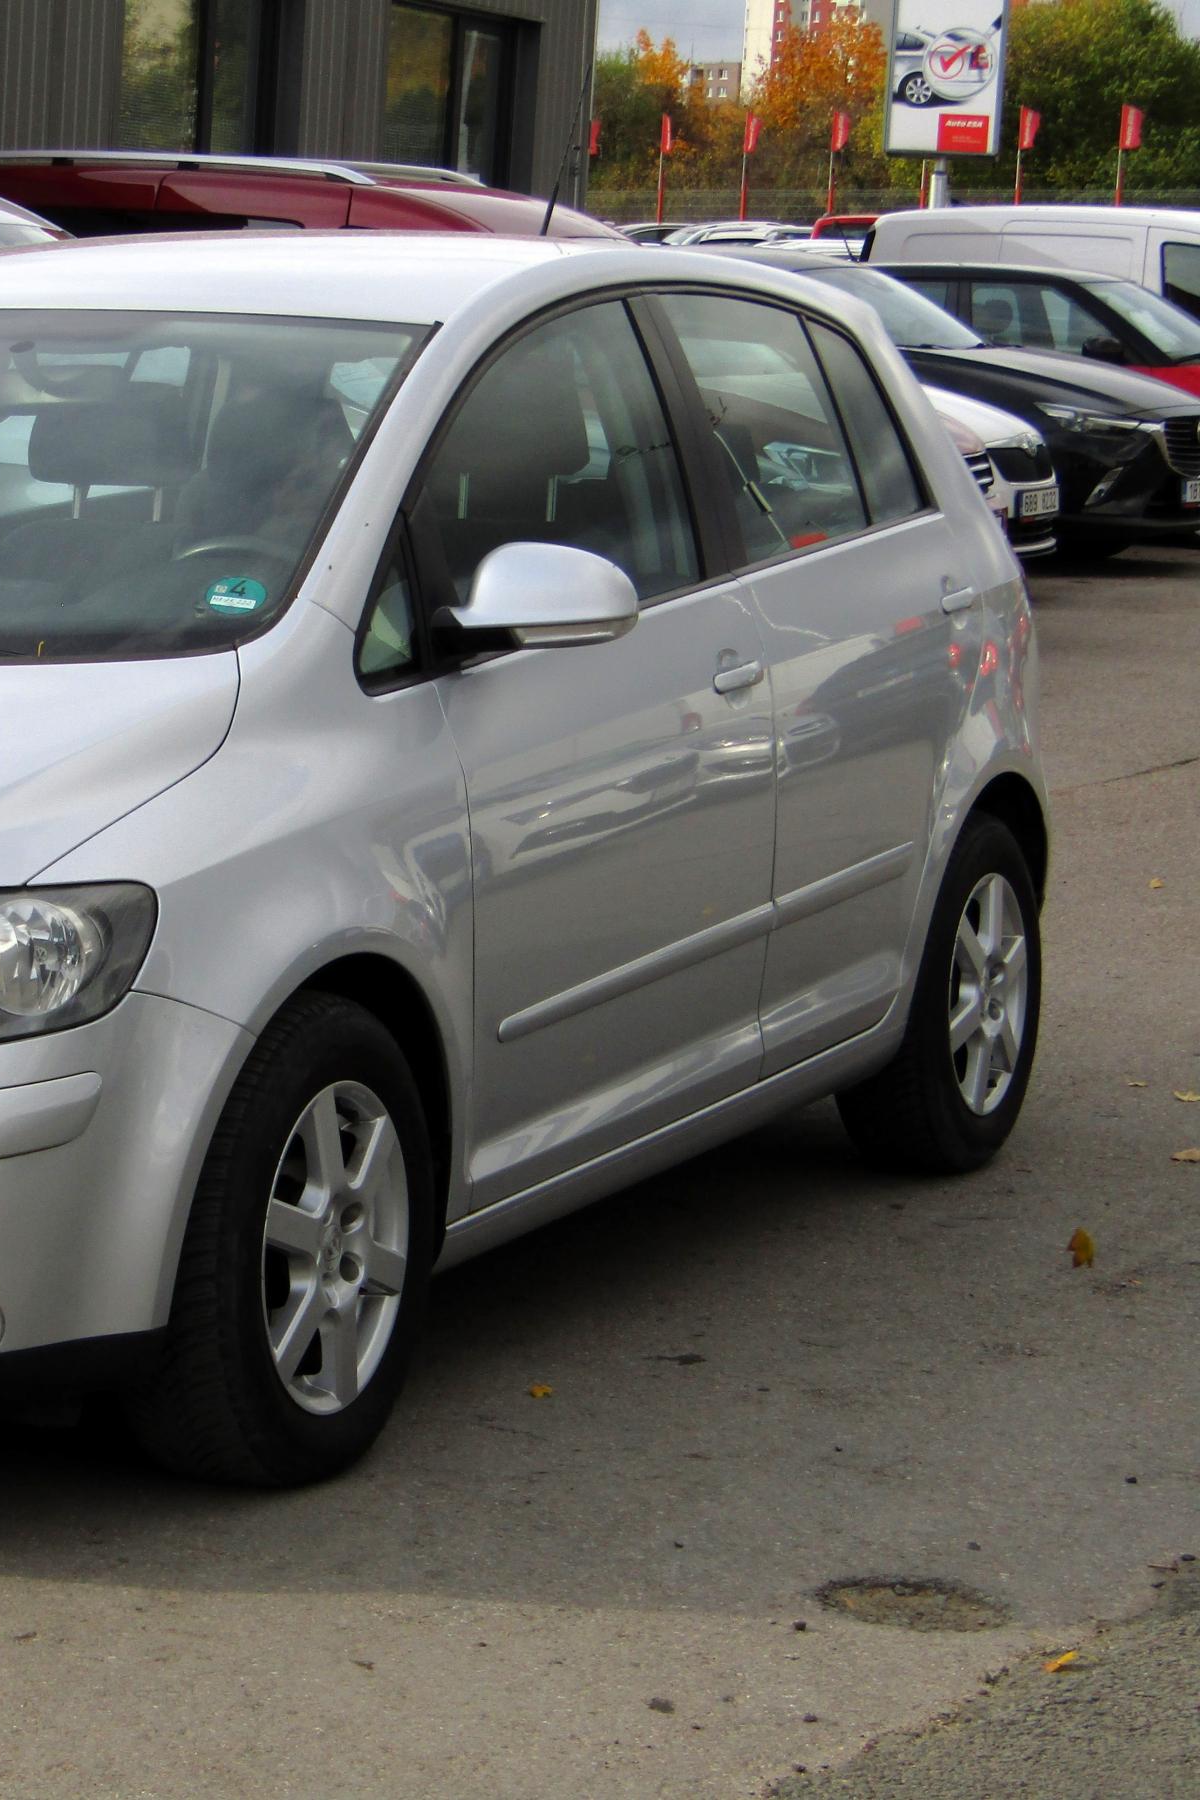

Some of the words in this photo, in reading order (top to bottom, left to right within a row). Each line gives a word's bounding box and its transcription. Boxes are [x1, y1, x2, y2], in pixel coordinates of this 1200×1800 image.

[945, 119, 966, 128] Auto
[966, 120, 984, 128] ESA
[229, 580, 247, 596] 4
